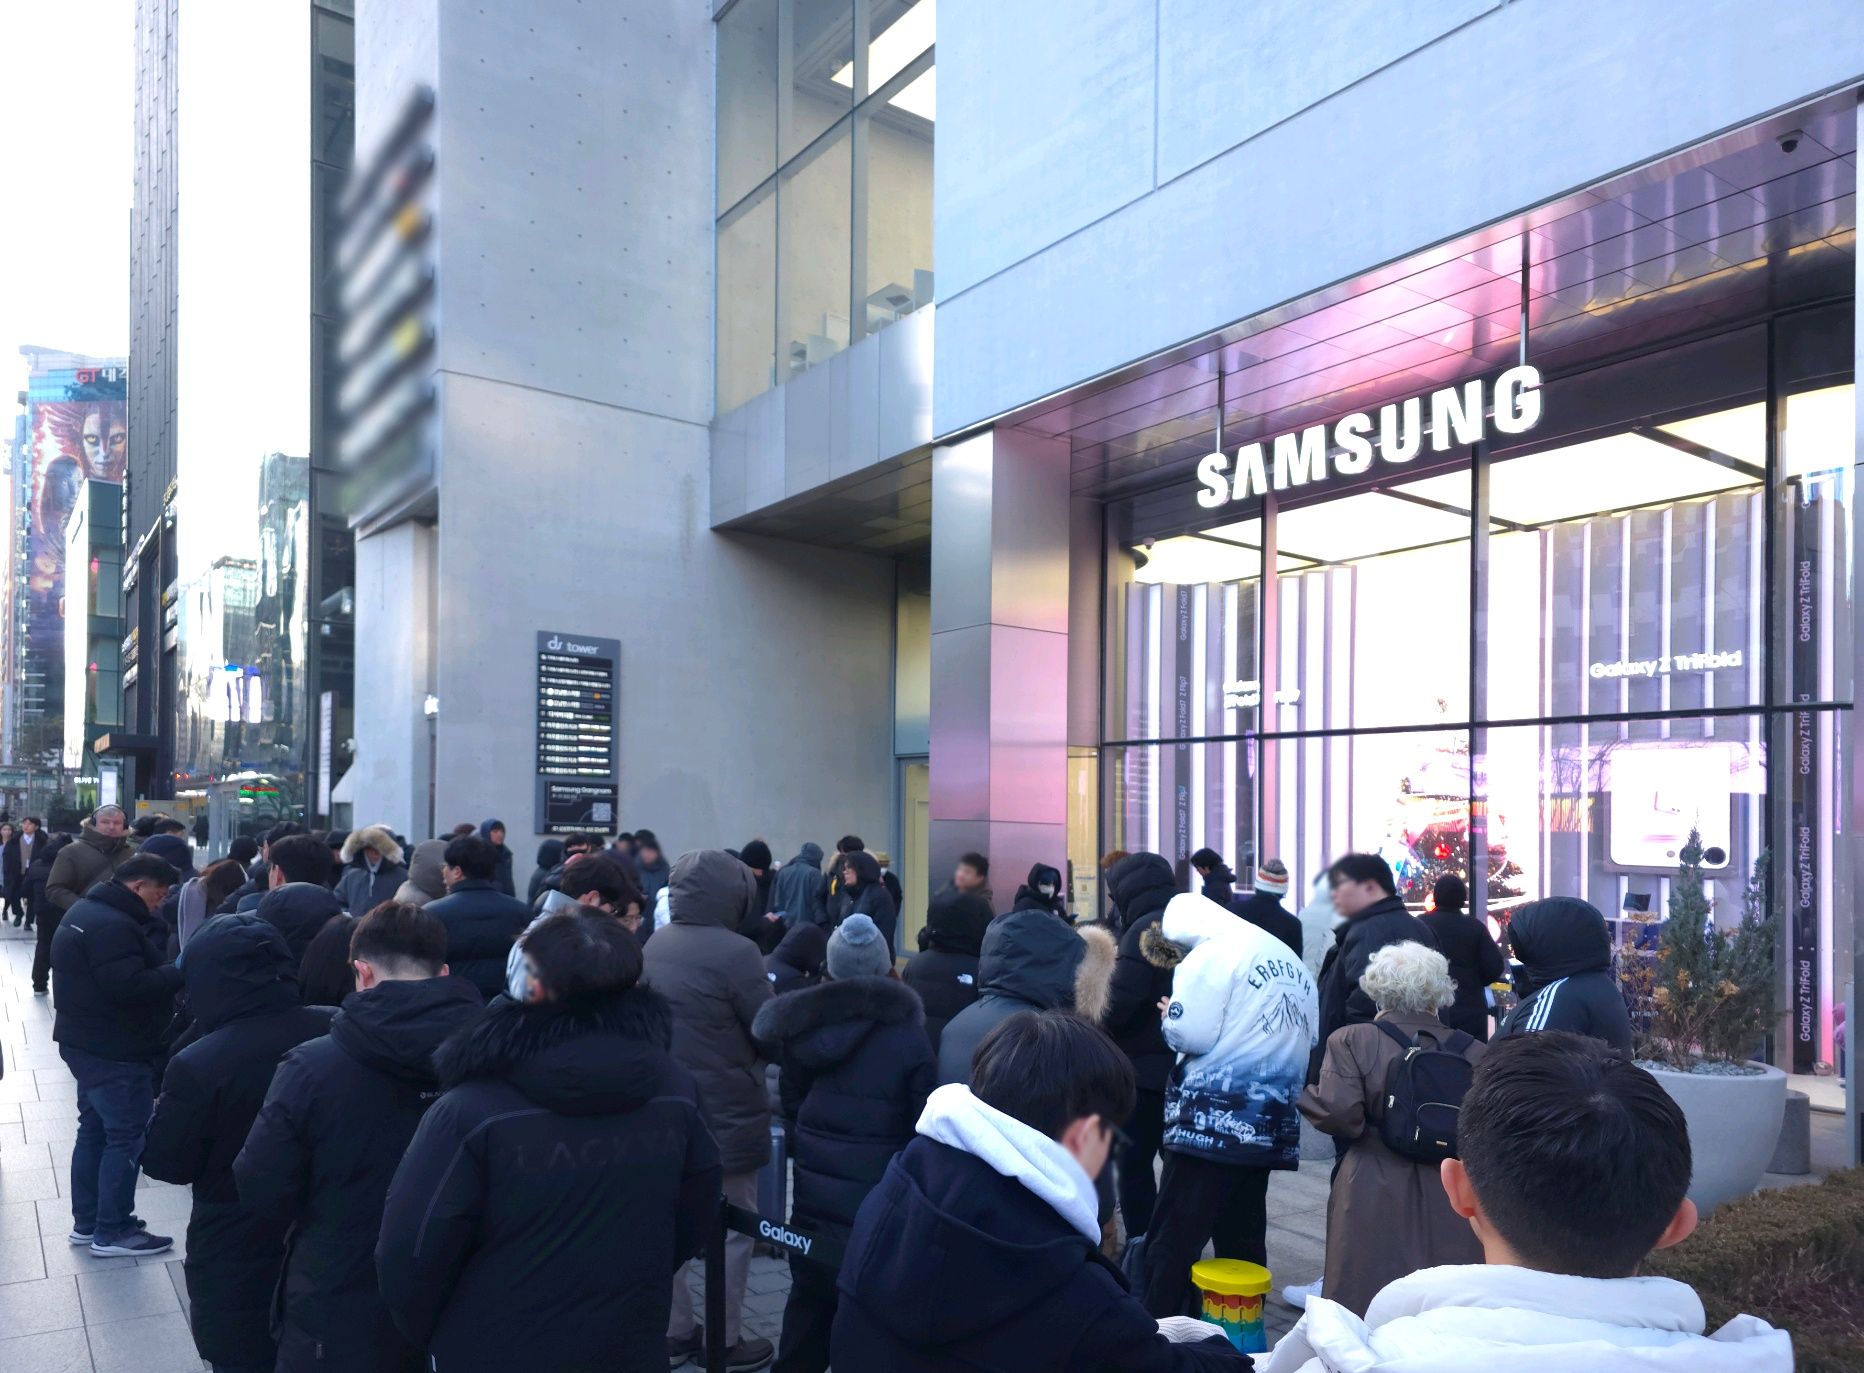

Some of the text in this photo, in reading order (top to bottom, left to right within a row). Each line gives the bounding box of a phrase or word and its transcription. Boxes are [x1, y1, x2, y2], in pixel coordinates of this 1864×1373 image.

[1197, 365, 1543, 508] SAMSUNG
[1800, 561, 1813, 641] Galaxy Z TriFold
[567, 642, 599, 654] tower
[1590, 660, 1658, 678] Galaxy
[1674, 650, 1742, 670] TriFold
[1800, 737, 1813, 775] Galaxy
[551, 785, 580, 794] Samsung
[1800, 826, 1811, 859] TriFold
[1800, 869, 1813, 908] Galaxy
[1800, 960, 1811, 995] TriFold
[1800, 1004, 1813, 1041] Galaxy
[759, 1220, 812, 1255] Galaxy
